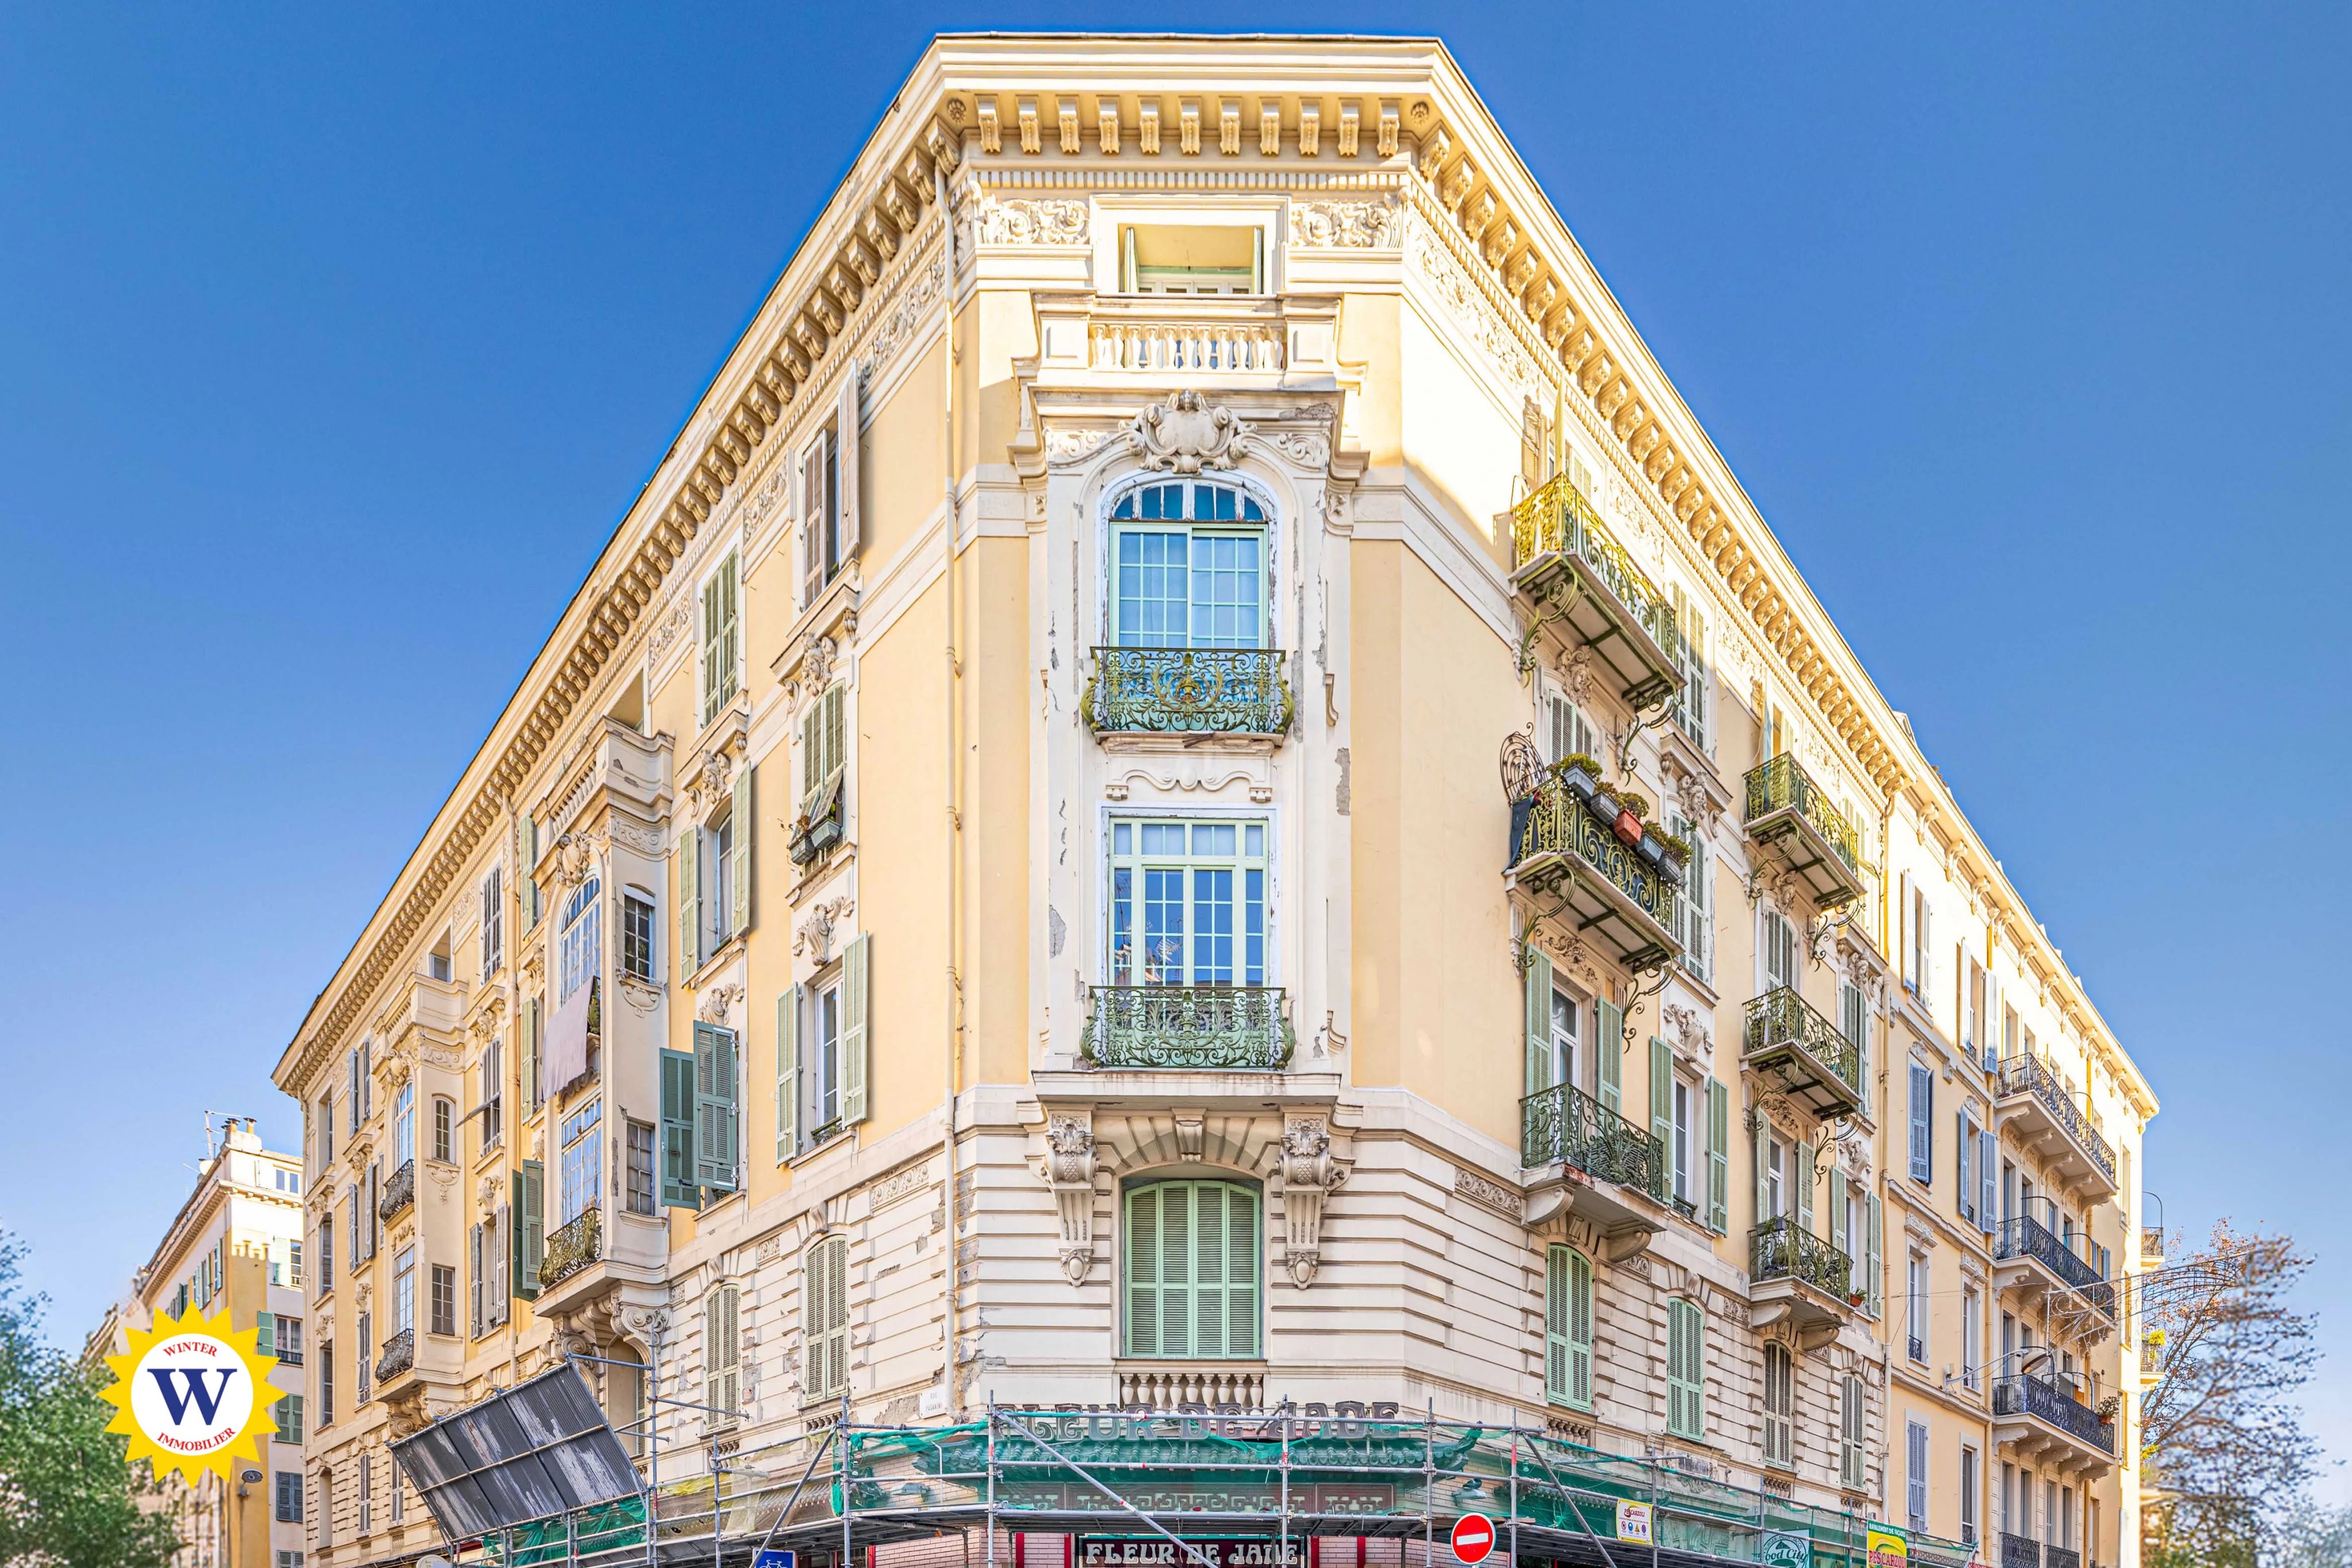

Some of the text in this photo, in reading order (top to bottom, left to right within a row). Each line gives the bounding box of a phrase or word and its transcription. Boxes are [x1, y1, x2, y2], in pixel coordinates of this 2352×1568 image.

[1178, 1402, 1243, 1440] DE
[1267, 1401, 1399, 1440] JADE
[1869, 1523, 1889, 1533] RAVALEMENT
[1086, 1543, 1298, 1565] FLEUR DE JADE
[1757, 1549, 1808, 1563] ood City
